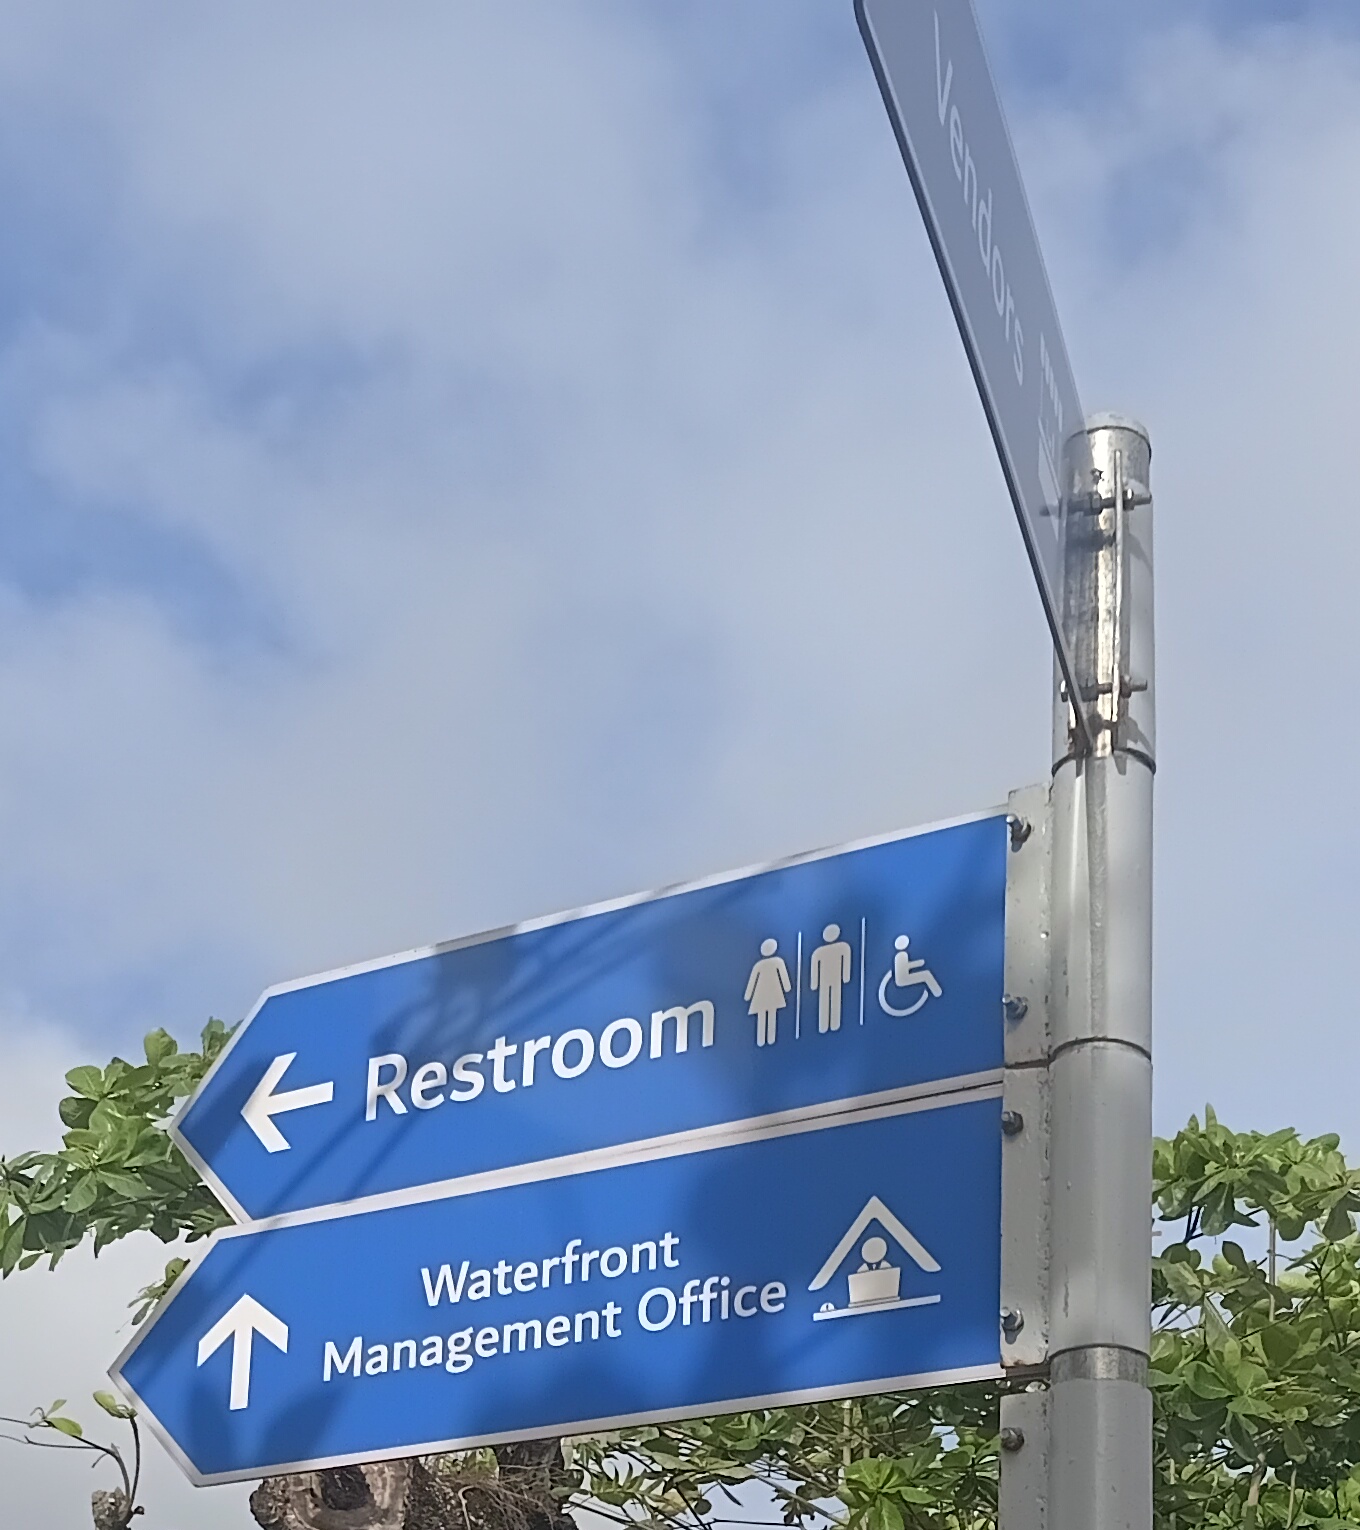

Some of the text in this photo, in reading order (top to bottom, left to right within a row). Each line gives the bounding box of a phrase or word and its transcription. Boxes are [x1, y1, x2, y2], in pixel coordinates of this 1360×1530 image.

[933, 7, 1024, 387] Vendors
[364, 999, 715, 1121] Restroom
[420, 1231, 680, 1307] Waterfront
[322, 1276, 787, 1382] Management Office
